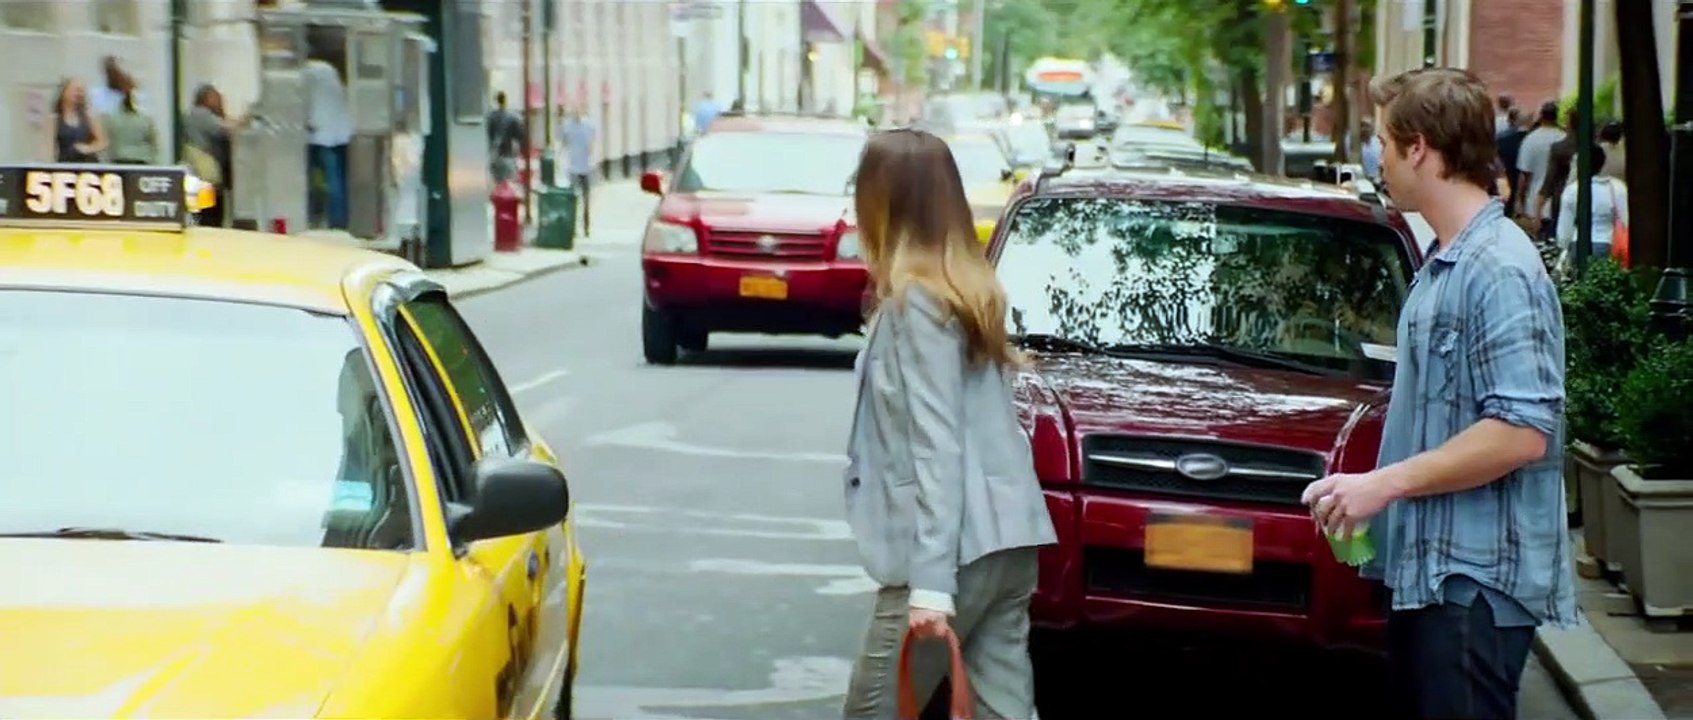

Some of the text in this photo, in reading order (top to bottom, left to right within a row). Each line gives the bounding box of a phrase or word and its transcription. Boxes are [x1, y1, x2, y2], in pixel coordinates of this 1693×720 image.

[138, 176, 173, 193] OFF
[25, 171, 124, 216] 5F68
[134, 201, 178, 217] DUTY
